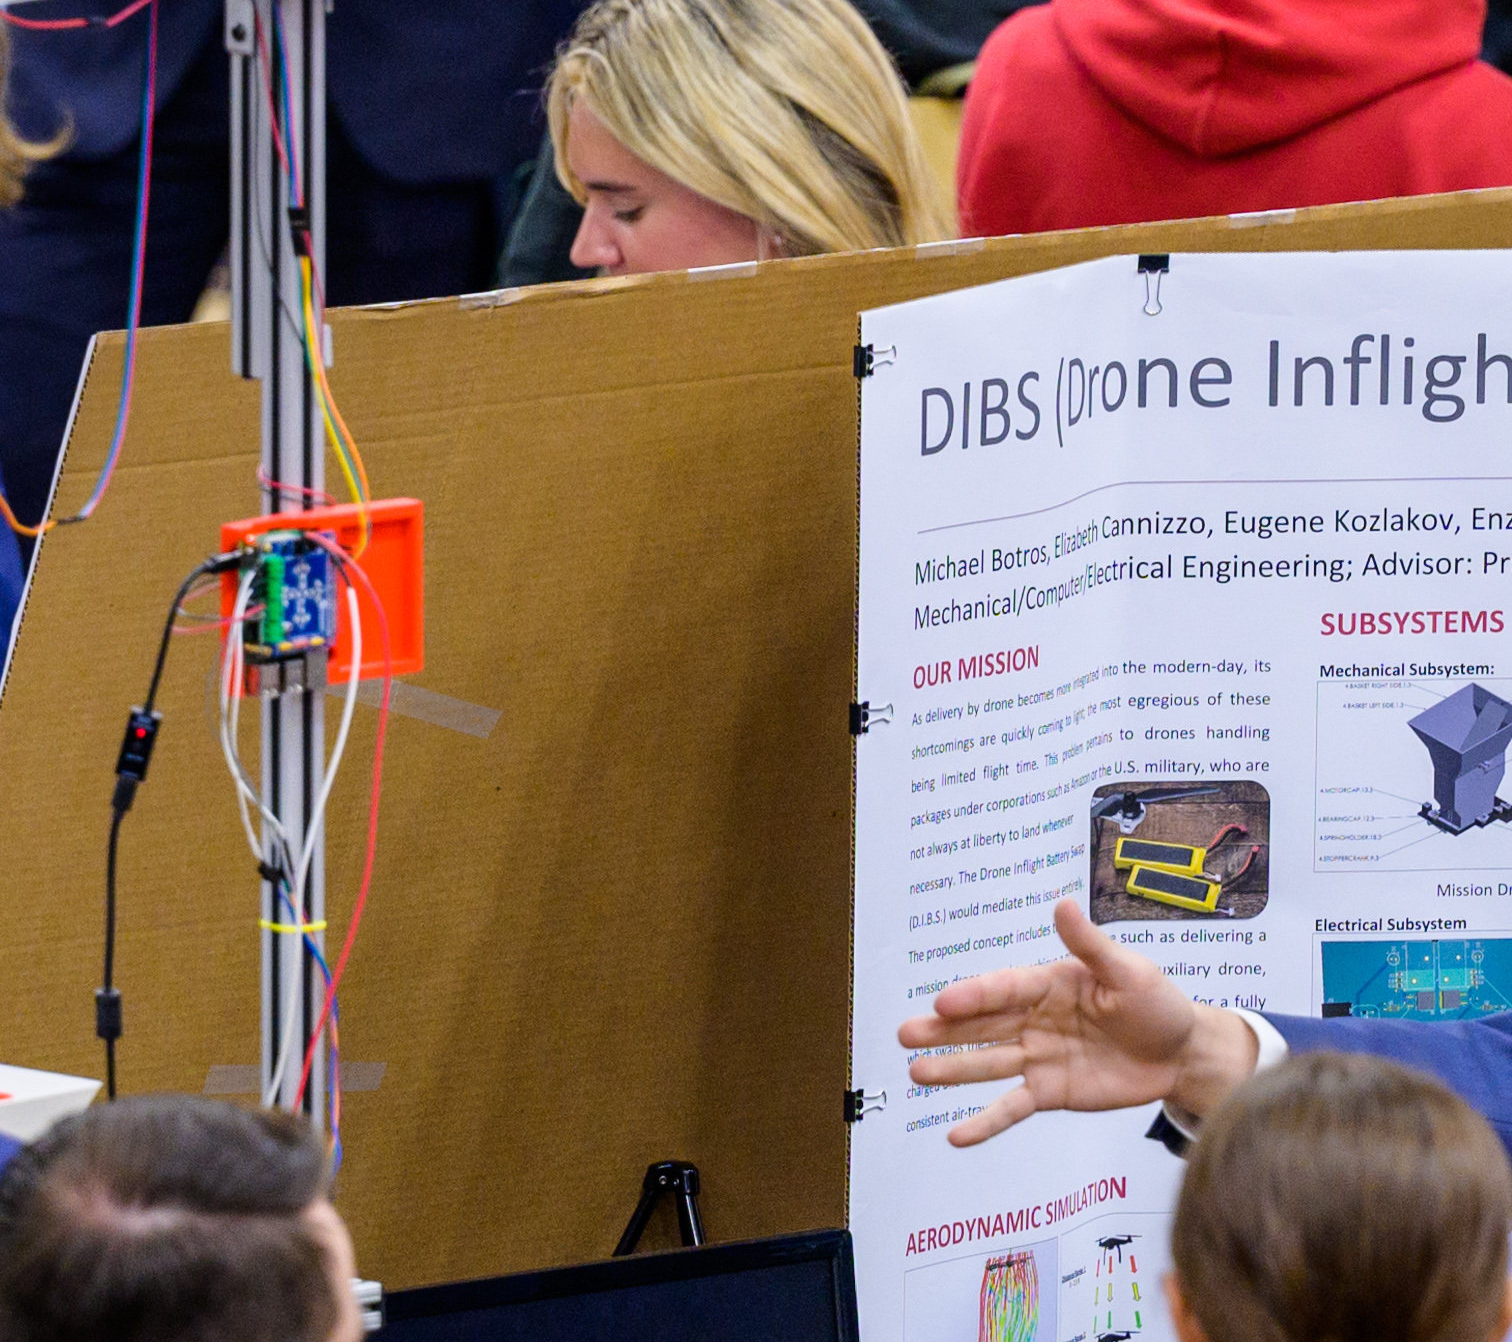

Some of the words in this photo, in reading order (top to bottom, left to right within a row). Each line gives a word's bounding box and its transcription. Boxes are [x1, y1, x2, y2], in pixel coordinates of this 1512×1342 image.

[922, 370, 1040, 458] DIBS
[1056, 349, 1232, 448] (Drone
[914, 549, 986, 586] Michael
[991, 544, 1050, 574] Botros,
[1054, 518, 1098, 561] Elizabeth
[1102, 509, 1213, 544] Cannizzo,
[1225, 509, 1323, 542] Eugene
[1333, 506, 1461, 539] Kozlakov,
[914, 549, 1173, 632] Mechanical/Computer/Electrical
[1182, 553, 1353, 583] Engineering;
[1362, 549, 1471, 578] Advisor:
[1321, 611, 1504, 635] SUBSYSTEMS
[913, 661, 951, 689] OUR
[959, 645, 1040, 681] MISSION
[1320, 664, 1404, 678] Mechanical
[1409, 663, 1494, 678] Subsystem:
[925, 706, 963, 724] delivery
[984, 698, 1013, 713] drone
[1102, 664, 1118, 679] into
[1123, 662, 1146, 674] the
[1153, 659, 1247, 675] modern-day,
[1254, 660, 1271, 673] its
[912, 736, 974, 760] shortcomings
[1128, 694, 1199, 710] egregious
[1207, 692, 1222, 707] of
[1230, 693, 1271, 706] these
[912, 777, 935, 794] being
[941, 767, 976, 786] limited
[1120, 728, 1133, 740] to
[1145, 727, 1195, 740] drones
[1206, 726, 1270, 742] handling
[910, 806, 951, 829] packages
[987, 790, 1046, 815] corporations
[1114, 760, 1139, 774] U.S.
[1145, 759, 1205, 775] military,
[1210, 759, 1241, 773] who
[1246, 760, 1269, 772] are
[1437, 883, 1492, 897] Mission
[909, 909, 946, 932] (D.I.B.S.)
[1315, 918, 1382, 931] Electrical
[1387, 917, 1467, 932] Subsystem
[927, 940, 970, 961] proposed
[973, 935, 1013, 953] concept
[1016, 925, 1051, 943] includes
[1121, 930, 1153, 943] such
[1160, 930, 1174, 943] as
[1181, 929, 1253, 945] delivering
[1259, 931, 1266, 942] a
[1218, 962, 1266, 978] drone,
[916, 979, 949, 999] mission
[1221, 997, 1228, 1008] a
[1235, 995, 1266, 1011] fully
[906, 1112, 949, 1133] consistent
[906, 1205, 1041, 1256] AERODYNAMIC
[1045, 1176, 1126, 1225] SIMULATION
